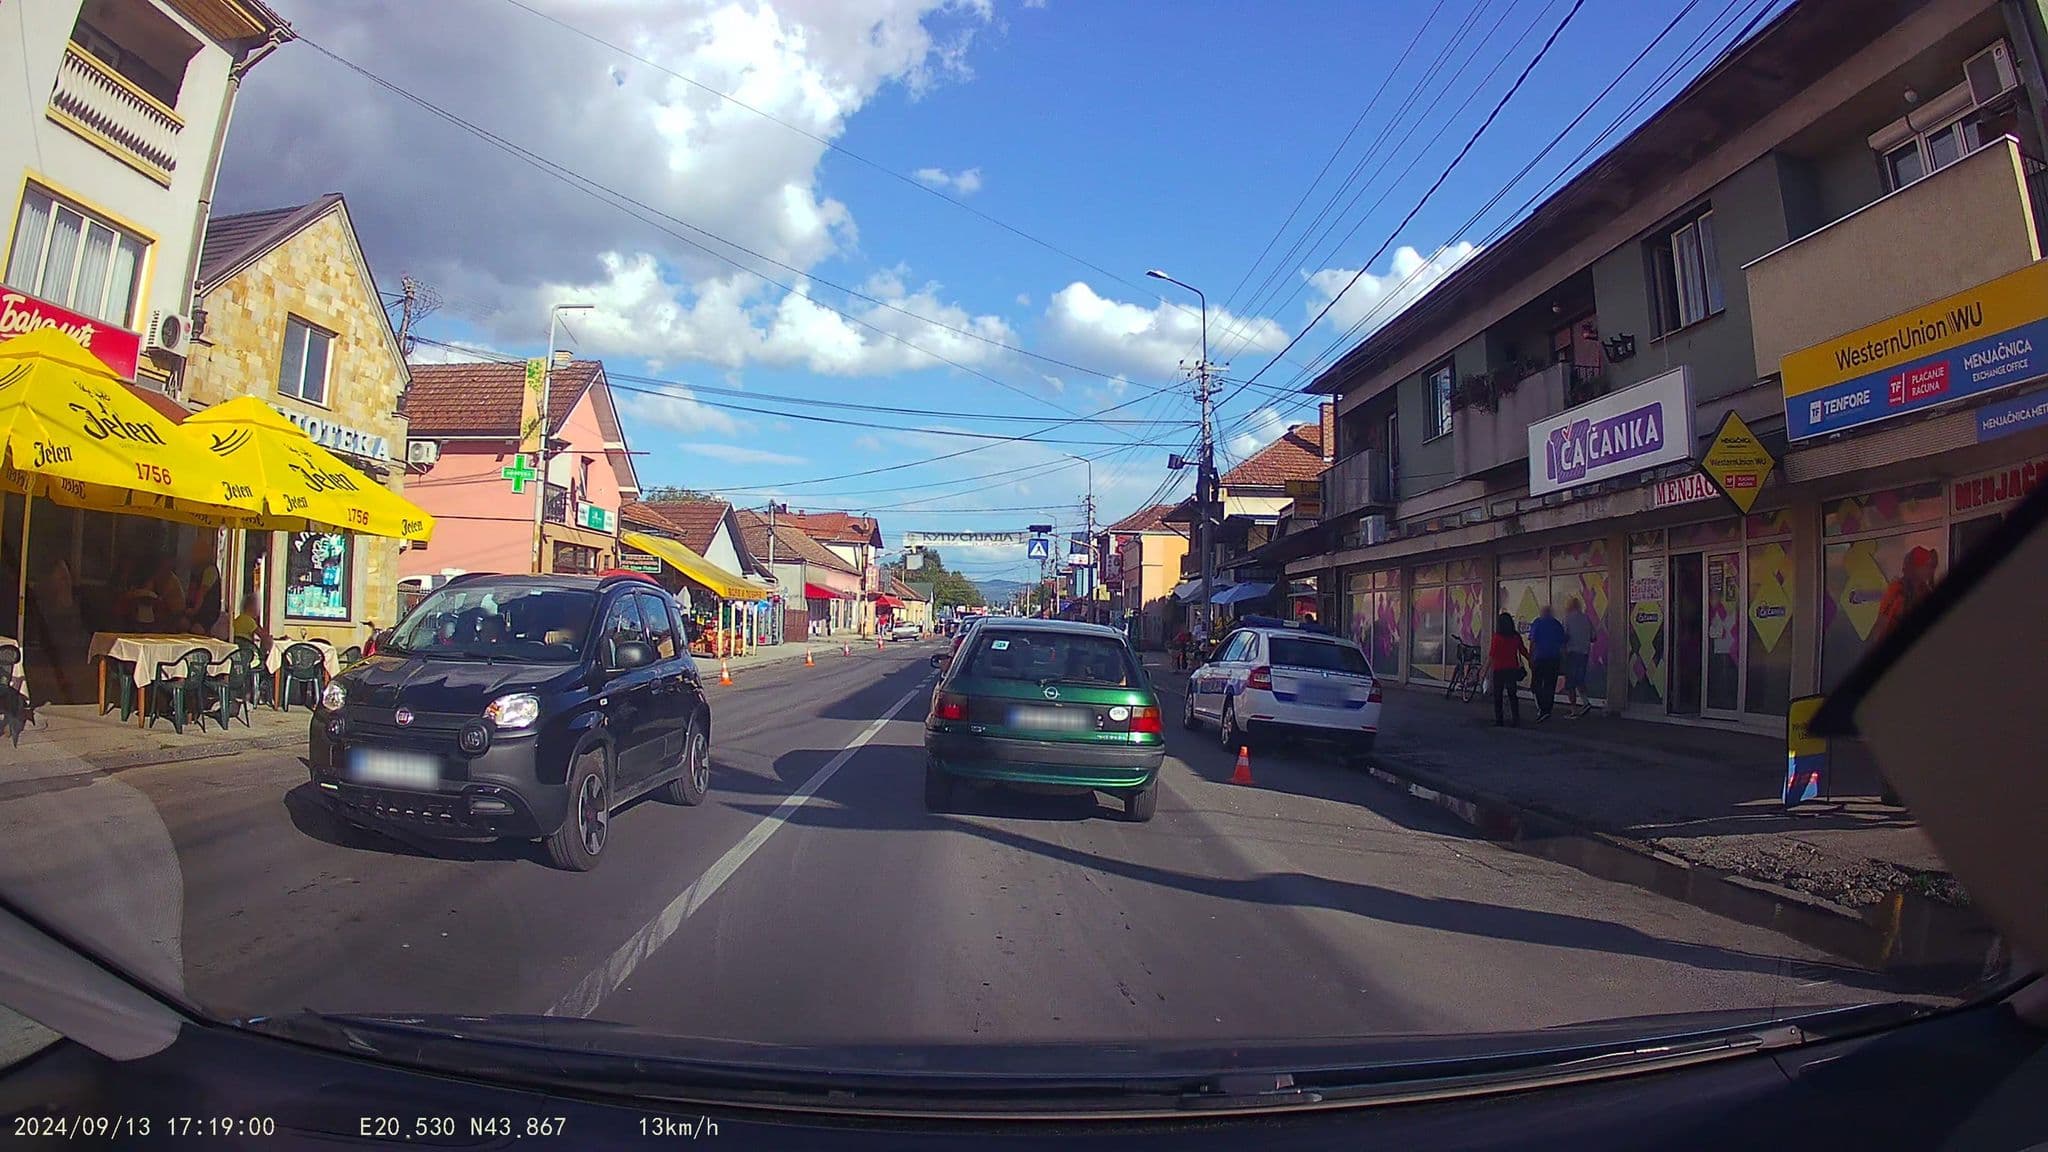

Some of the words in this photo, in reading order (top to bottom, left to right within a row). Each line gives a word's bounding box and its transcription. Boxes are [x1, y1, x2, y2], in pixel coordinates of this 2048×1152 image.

[1834, 319, 1948, 371] WesternUnion
[1963, 338, 2033, 371] MENJAČNICA
[1972, 365, 2006, 383] EXCHANGE
[2006, 358, 2029, 375] OFFICE
[1823, 390, 1871, 415] TENFORE
[68, 402, 167, 446] Jelen
[34, 441, 73, 468] Jelen
[136, 462, 172, 486] 1756
[288, 463, 360, 493] Jelen
[221, 480, 253, 501] Jelen
[283, 494, 309, 513] Jelen
[347, 508, 369, 526] 1756
[401, 518, 424, 537] Jelen
